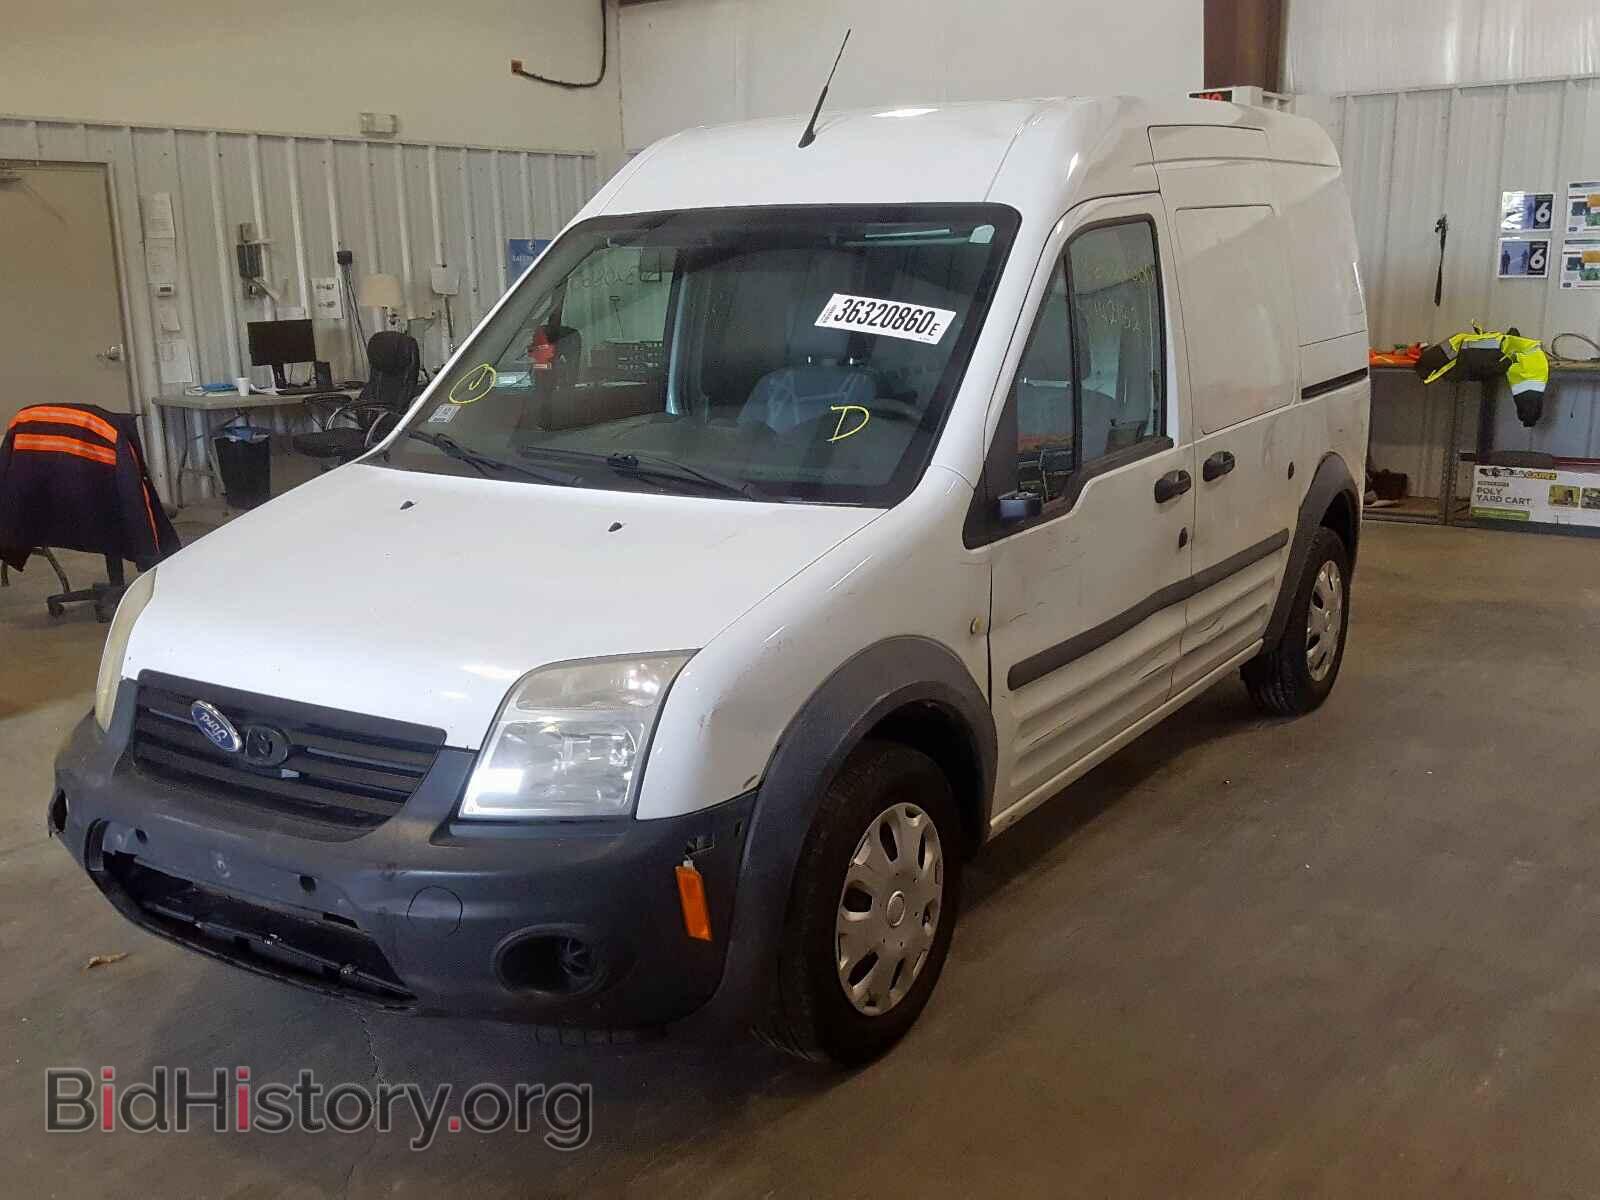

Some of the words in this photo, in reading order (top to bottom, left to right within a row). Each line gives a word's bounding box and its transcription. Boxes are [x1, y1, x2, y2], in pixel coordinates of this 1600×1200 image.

[1536, 202, 1550, 223] 6
[1529, 249, 1545, 270] 6
[825, 405, 870, 444] D
[1476, 486, 1503, 495] POLY
[1476, 494, 1503, 503] YARD
[1504, 496, 1533, 505] CART
